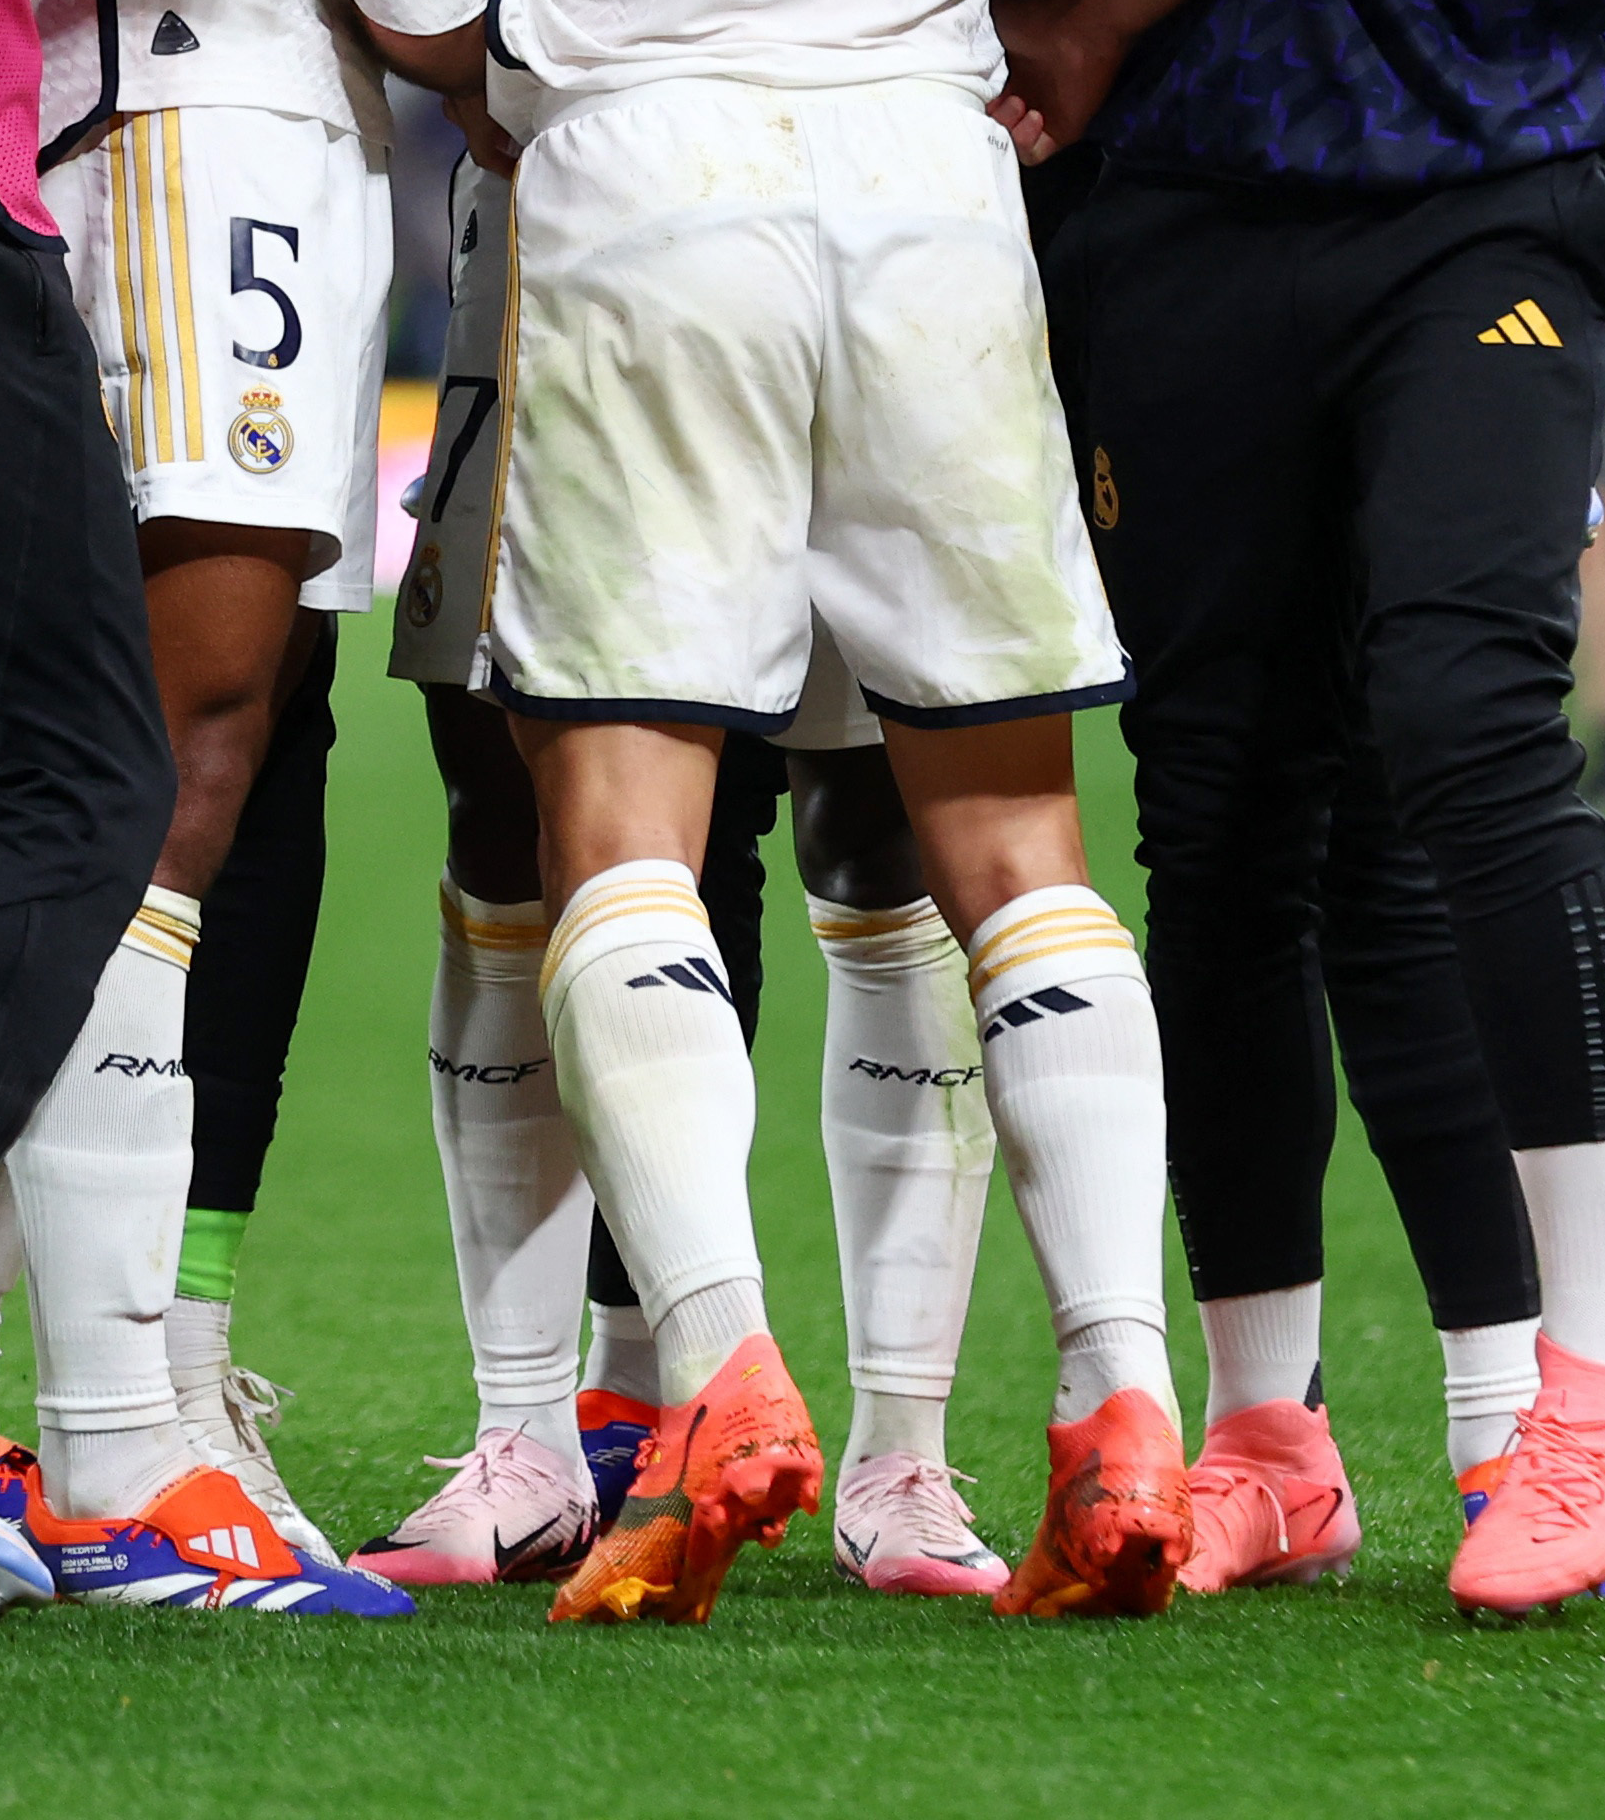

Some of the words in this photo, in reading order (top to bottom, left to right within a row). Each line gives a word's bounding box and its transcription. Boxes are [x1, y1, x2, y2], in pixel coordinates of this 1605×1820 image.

[229, 216, 303, 370] 5
[430, 374, 500, 524] 7
[93, 1052, 186, 1078] RM
[61, 1544, 107, 1555] PREDATOR
